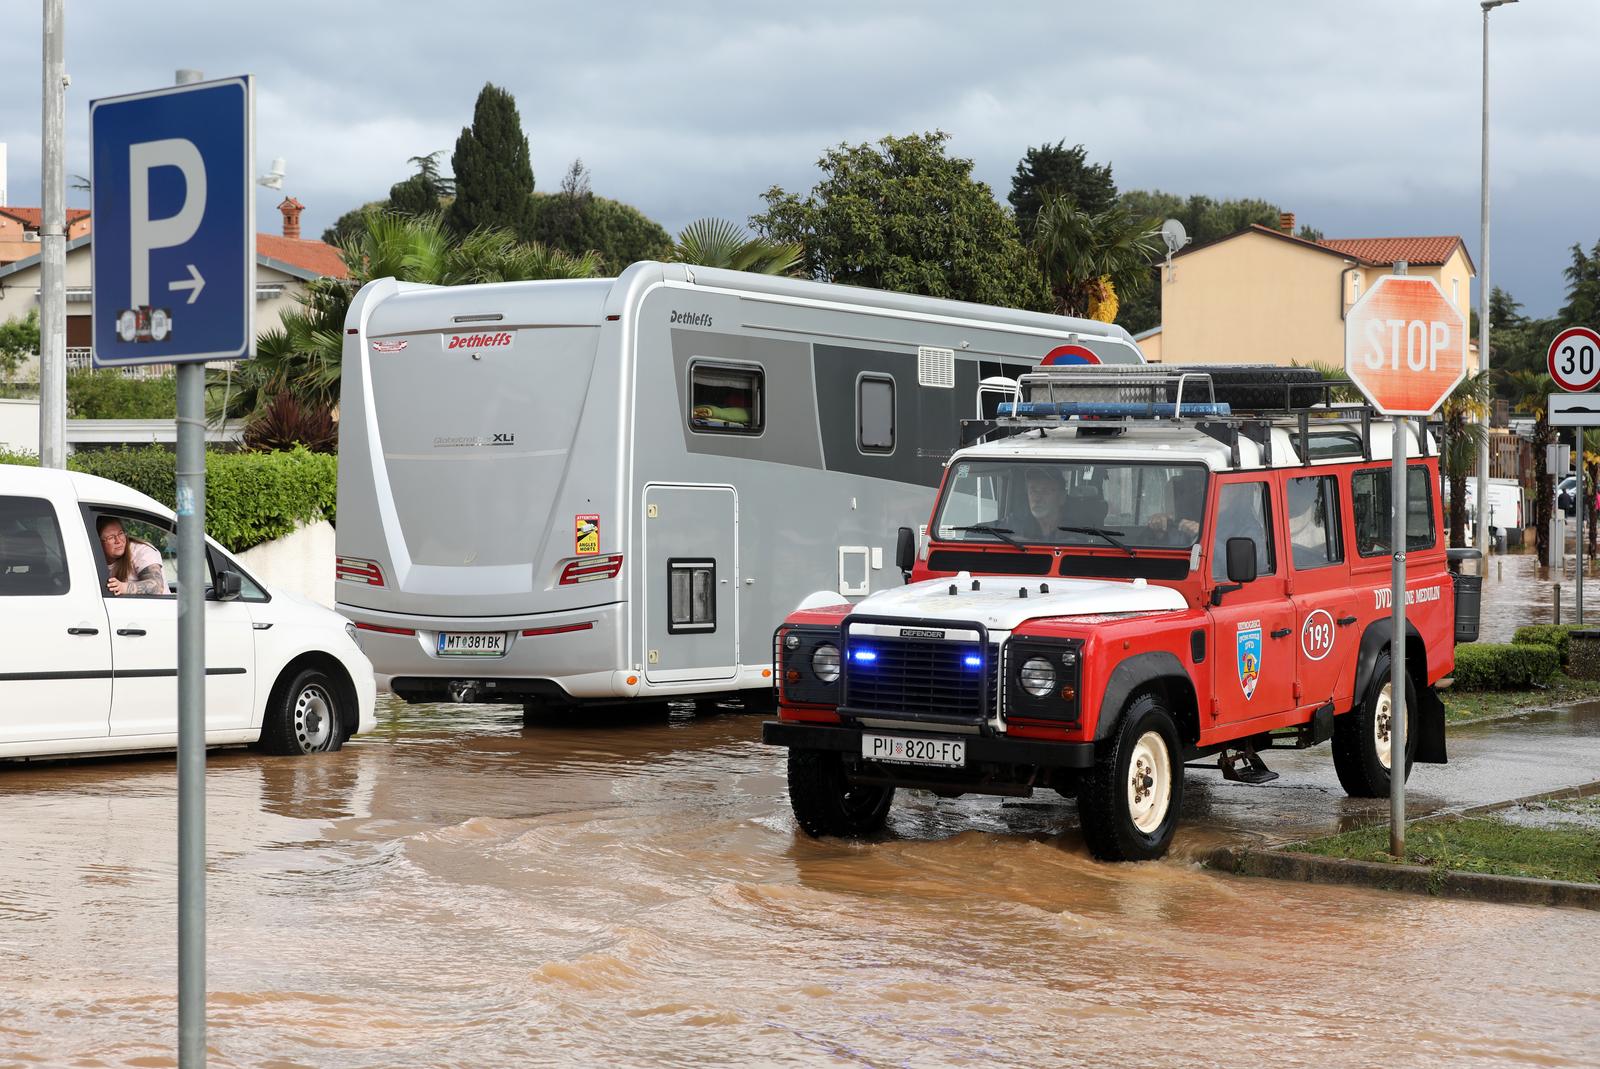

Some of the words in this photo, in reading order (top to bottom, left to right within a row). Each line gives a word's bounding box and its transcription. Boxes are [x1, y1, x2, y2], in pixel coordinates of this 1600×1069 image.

[129, 138, 207, 310] P
[670, 310, 713, 327] Dethleffs
[448, 332, 512, 349] Dethleffs
[1364, 319, 1450, 372] STOP
[1561, 345, 1594, 375] 30
[493, 433, 514, 442] XLi
[1373, 588, 1392, 610] DVD
[1416, 586, 1440, 603] MEDULIN
[447, 635, 461, 648] MT
[467, 636, 501, 649] 381BK
[902, 630, 942, 638] DEFENDER
[1309, 623, 1329, 651] 193
[905, 740, 961, 762] 820-FC
